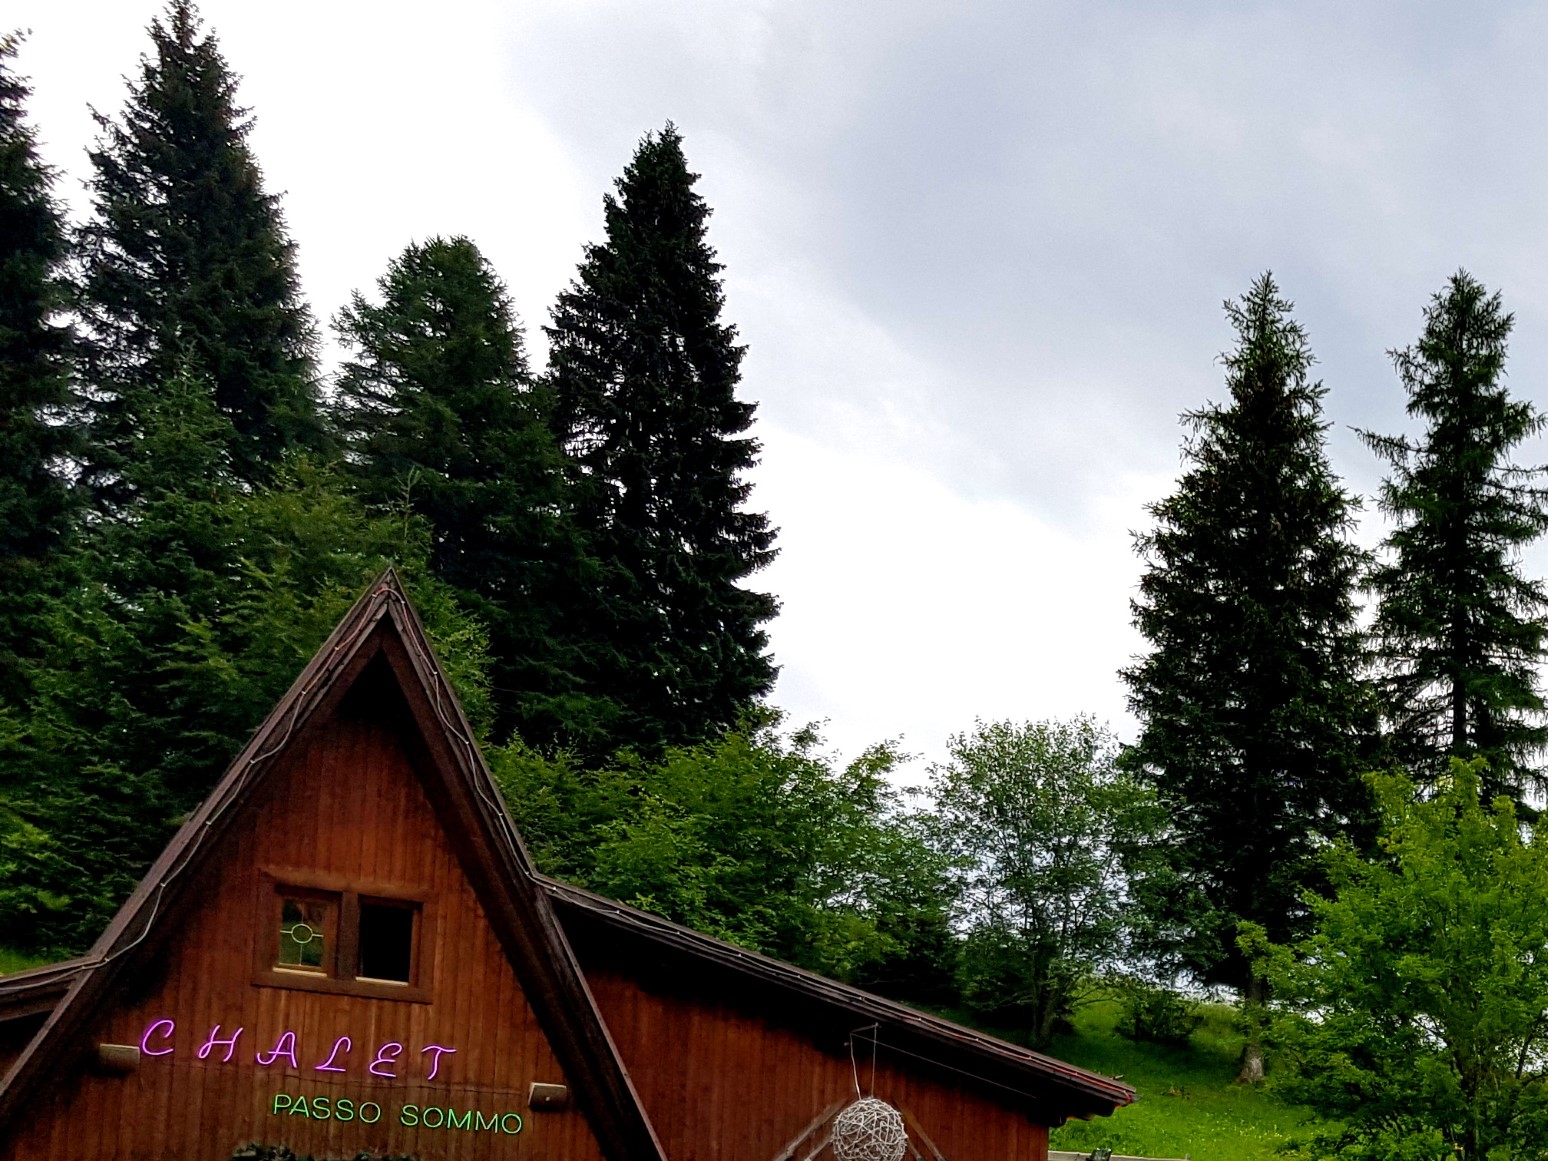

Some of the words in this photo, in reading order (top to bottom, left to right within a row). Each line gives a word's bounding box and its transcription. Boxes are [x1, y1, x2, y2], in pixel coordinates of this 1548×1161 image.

[141, 1018, 457, 1081] CHALET
[273, 1093, 381, 1124] PASSO
[400, 1104, 523, 1134] SOMMO
